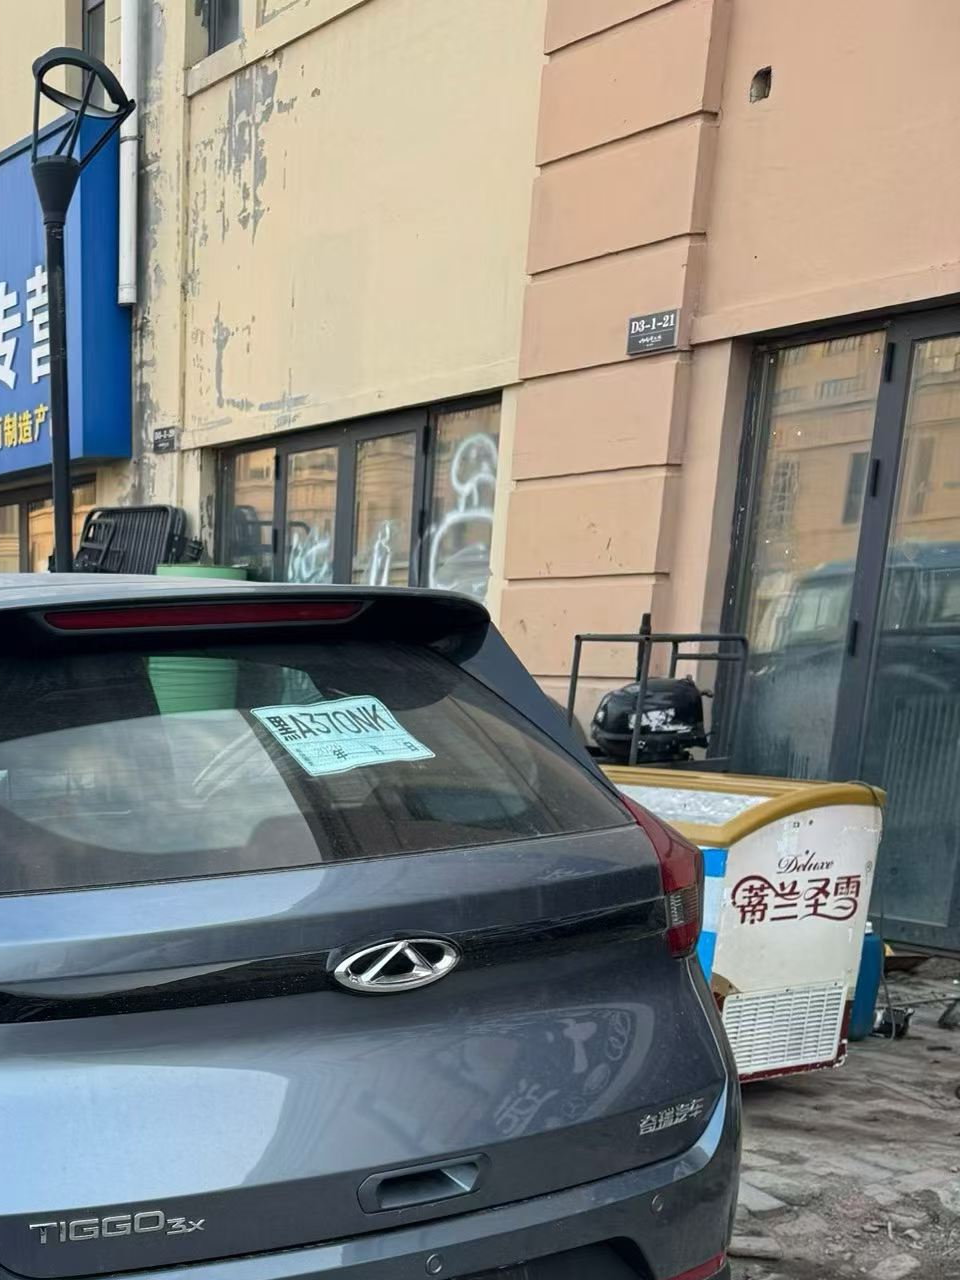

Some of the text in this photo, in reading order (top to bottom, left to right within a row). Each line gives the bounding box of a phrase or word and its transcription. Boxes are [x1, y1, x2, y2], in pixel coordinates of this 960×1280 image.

[631, 313, 676, 334] D3-1-21
[776, 851, 834, 874] Deluxe
[731, 874, 862, 925] 蒂兰圣雪
[639, 1097, 704, 1136] 奇瑞汽车
